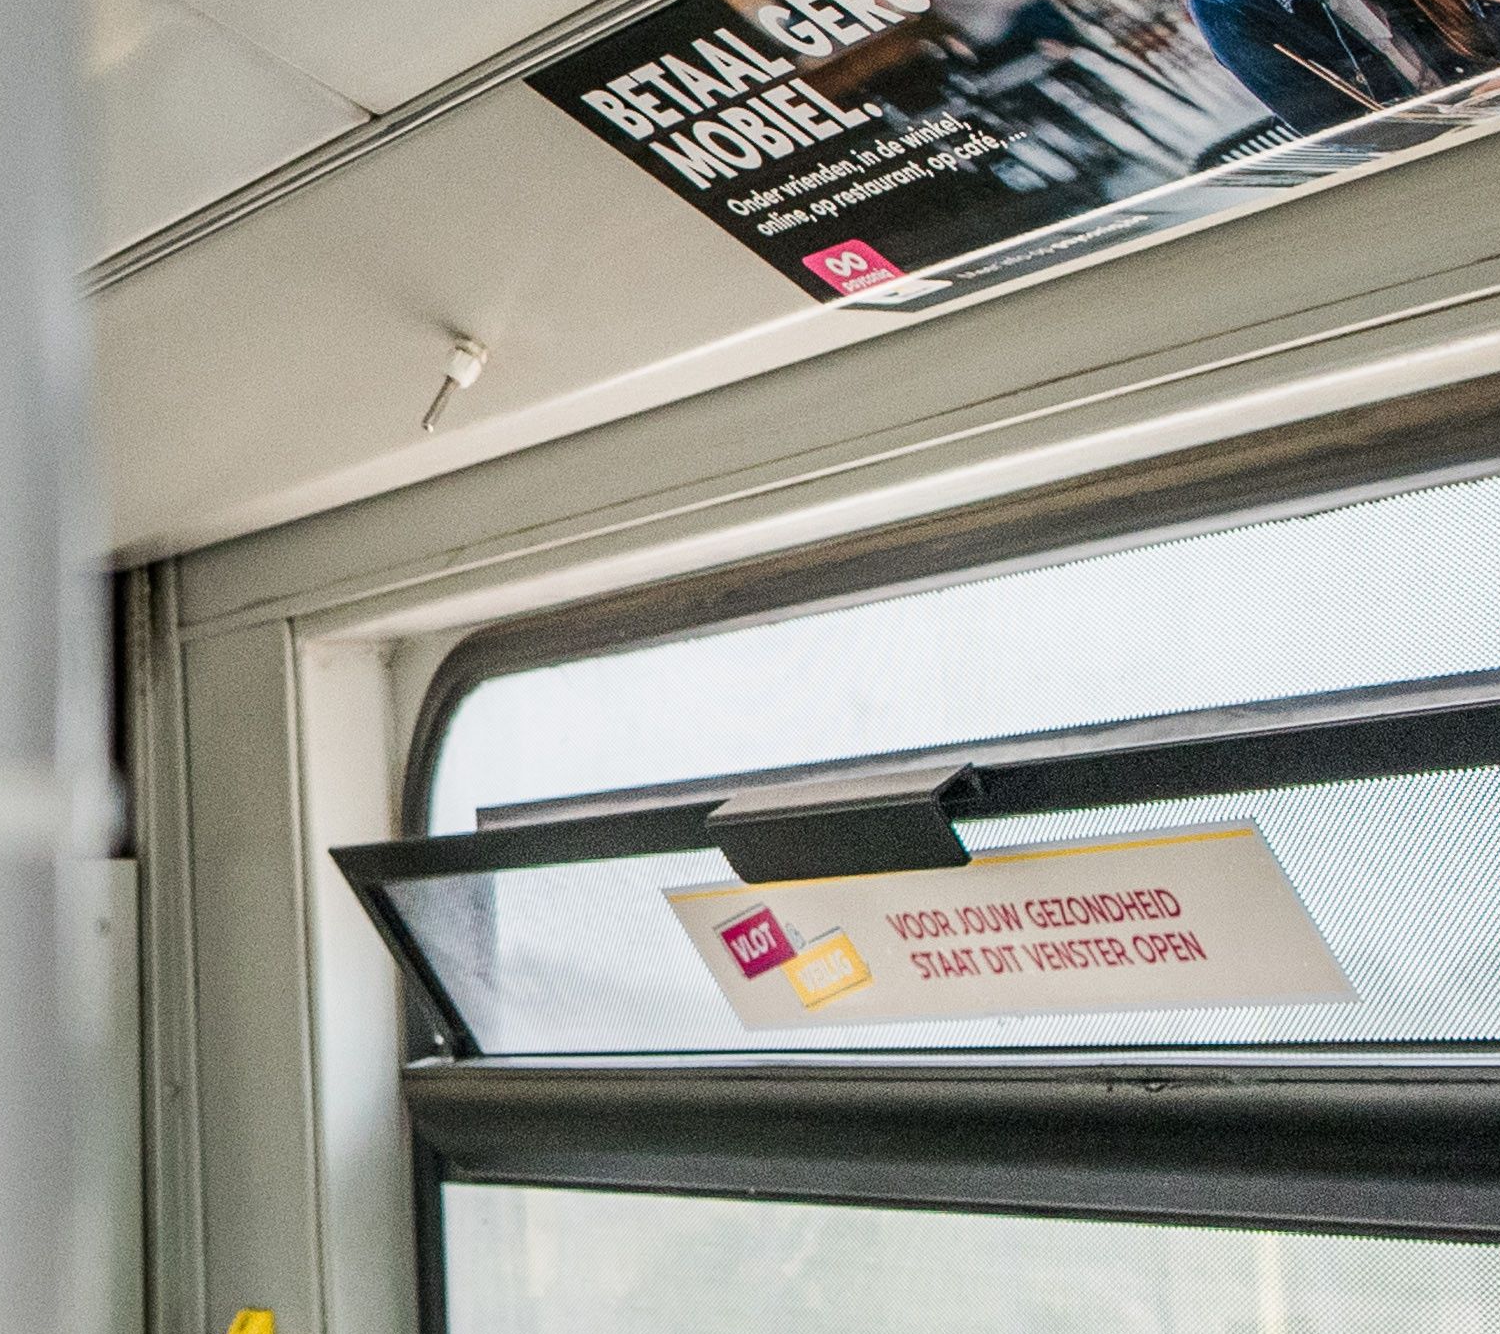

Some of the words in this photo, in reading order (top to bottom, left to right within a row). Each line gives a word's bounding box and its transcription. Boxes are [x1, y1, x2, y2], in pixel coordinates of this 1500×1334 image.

[579, 27, 796, 141] BETAAL
[648, 77, 883, 192] MOBIEL.
[726, 184, 783, 217] Onder
[778, 161, 866, 199] vrienden,
[850, 148, 882, 169] in
[874, 137, 905, 159] de
[898, 111, 972, 151] winkel,
[756, 205, 818, 237] online,
[811, 197, 839, 218] op
[836, 160, 933, 207] restaurant,
[927, 150, 959, 173] op
[953, 127, 1009, 161] café,
[730, 921, 777, 962] VLOT
[886, 910, 958, 941] VOOR
[956, 902, 1023, 936] JOUW
[1025, 889, 1181, 929] GEZONDHEID
[910, 947, 982, 980] STAAT
[980, 945, 1023, 974] DIT
[1022, 937, 1135, 973] VENSTER
[1133, 931, 1207, 964] OPEN
